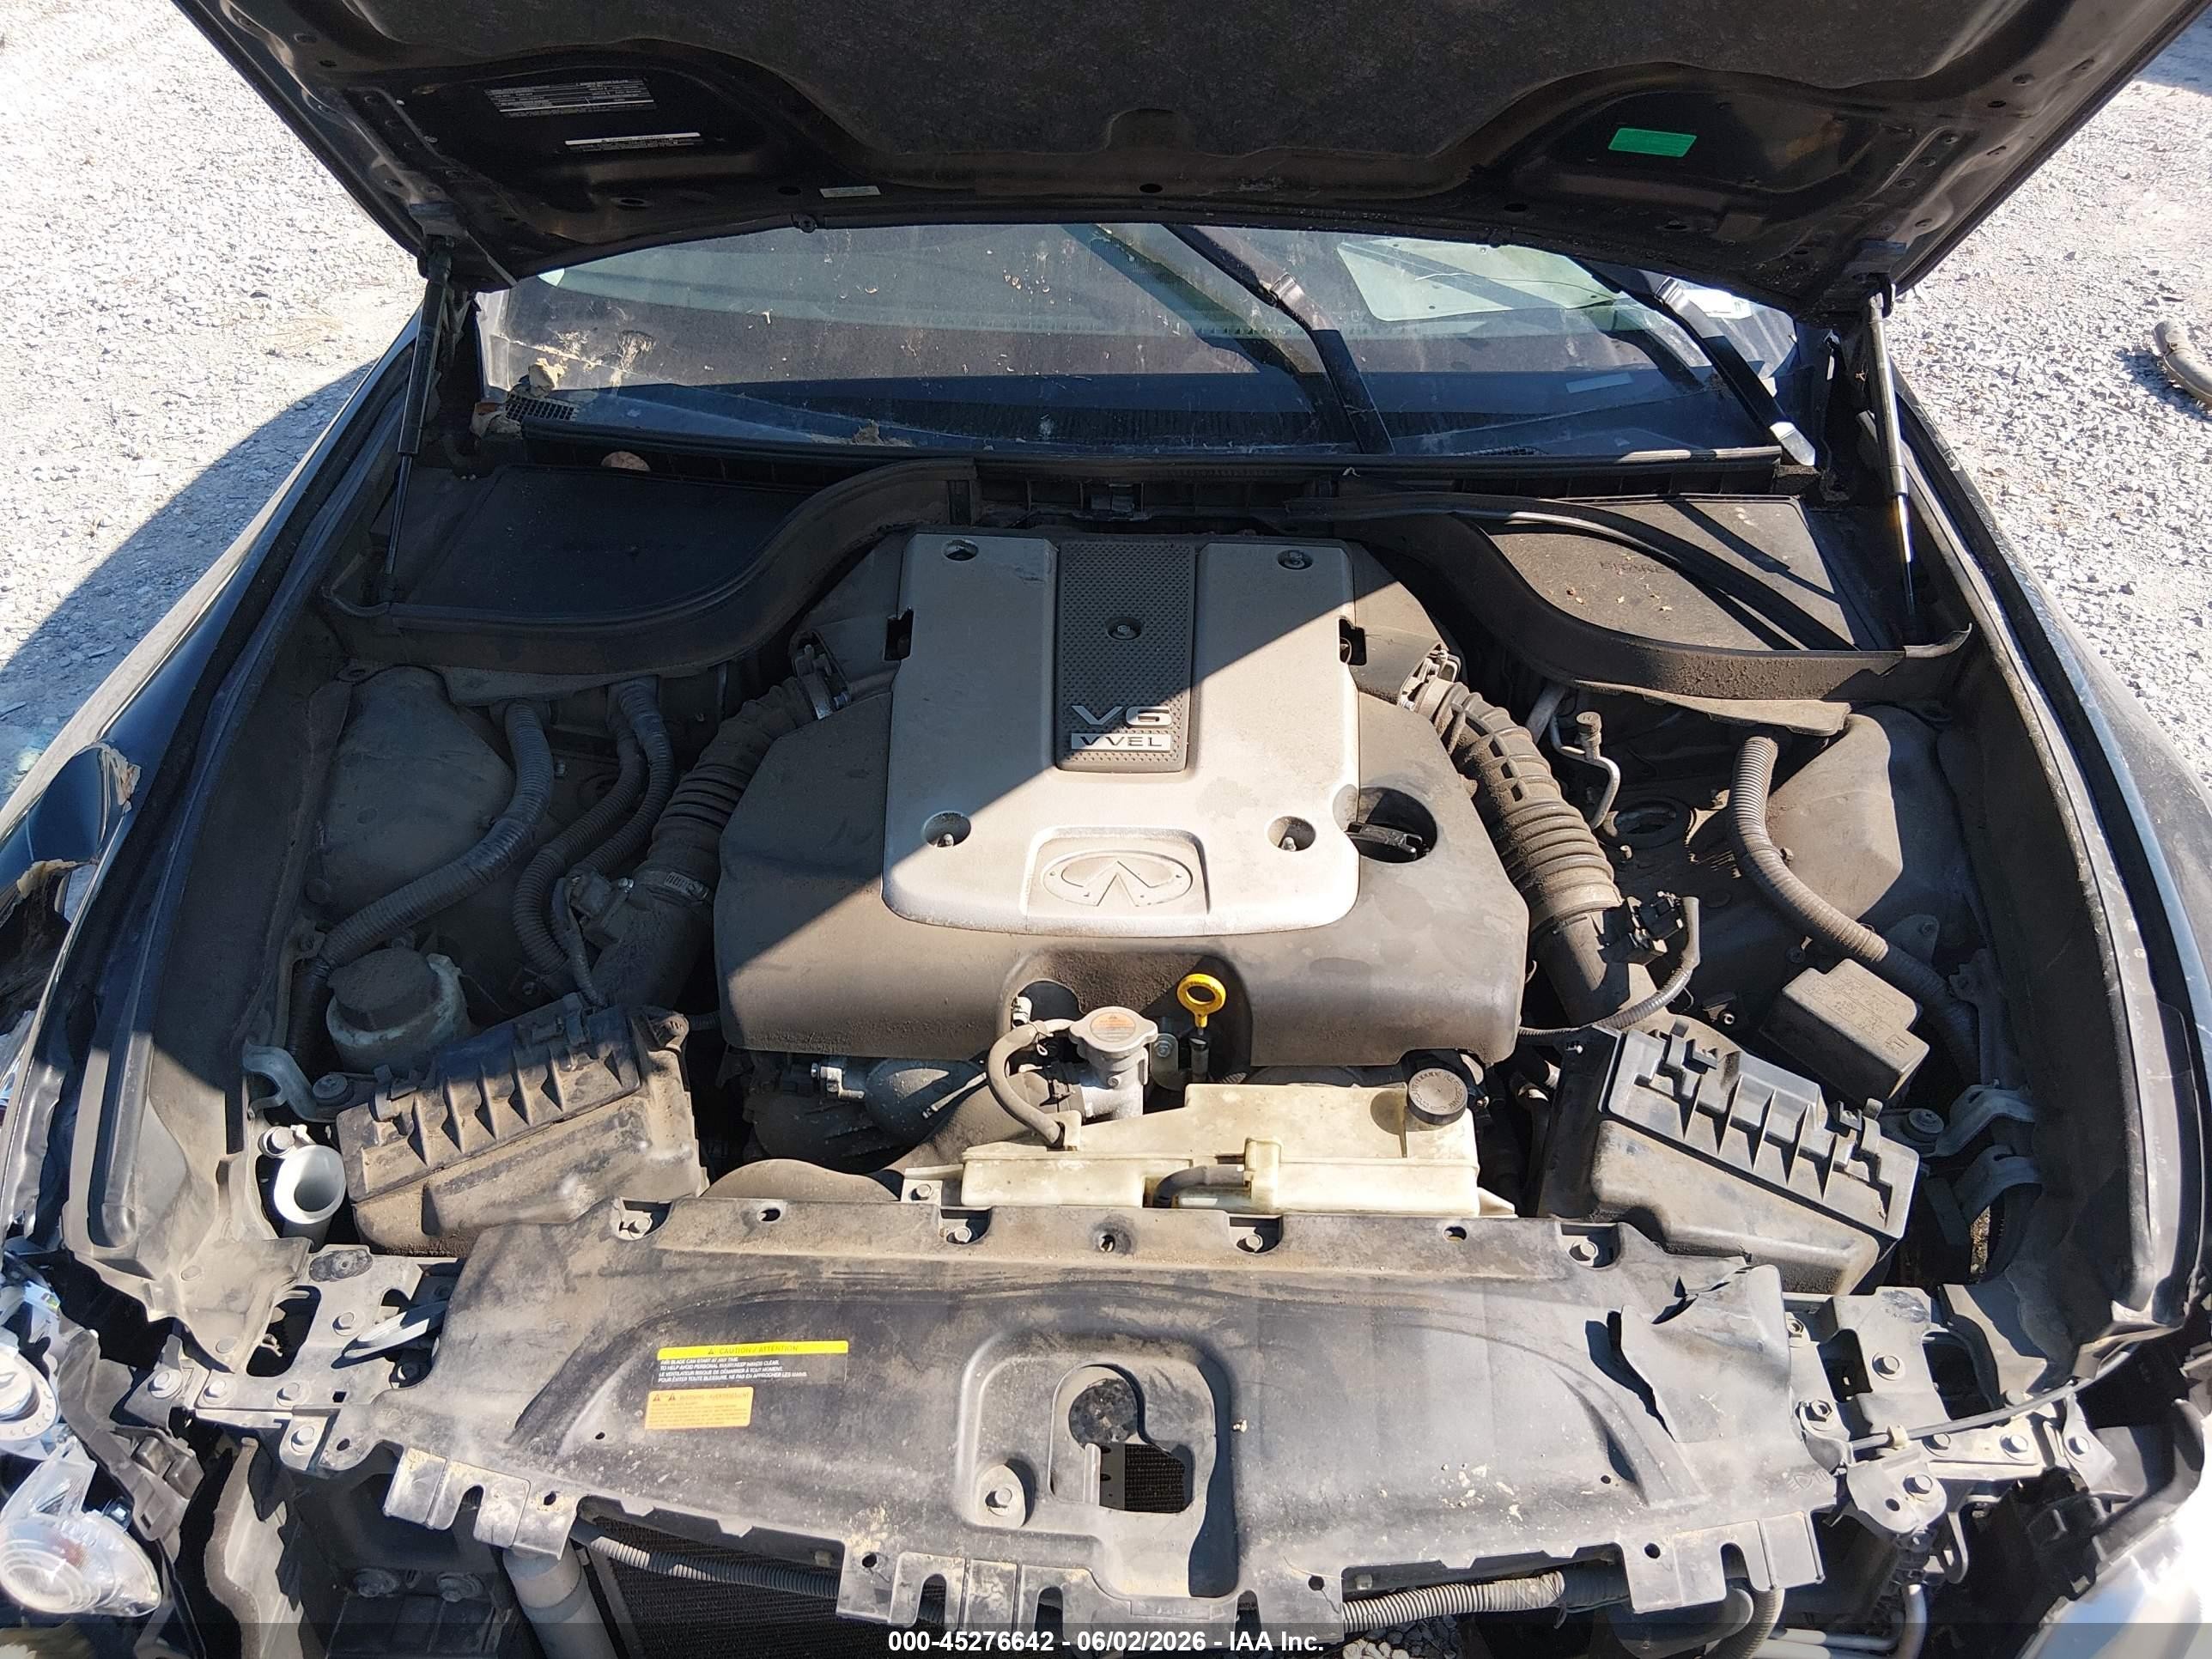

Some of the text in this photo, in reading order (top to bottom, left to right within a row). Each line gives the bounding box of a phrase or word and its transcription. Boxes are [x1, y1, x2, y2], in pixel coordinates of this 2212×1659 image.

[1071, 705, 1171, 726] V6
[1079, 736, 1163, 746] VVEL
[758, 1345, 798, 1353] ATTENTION
